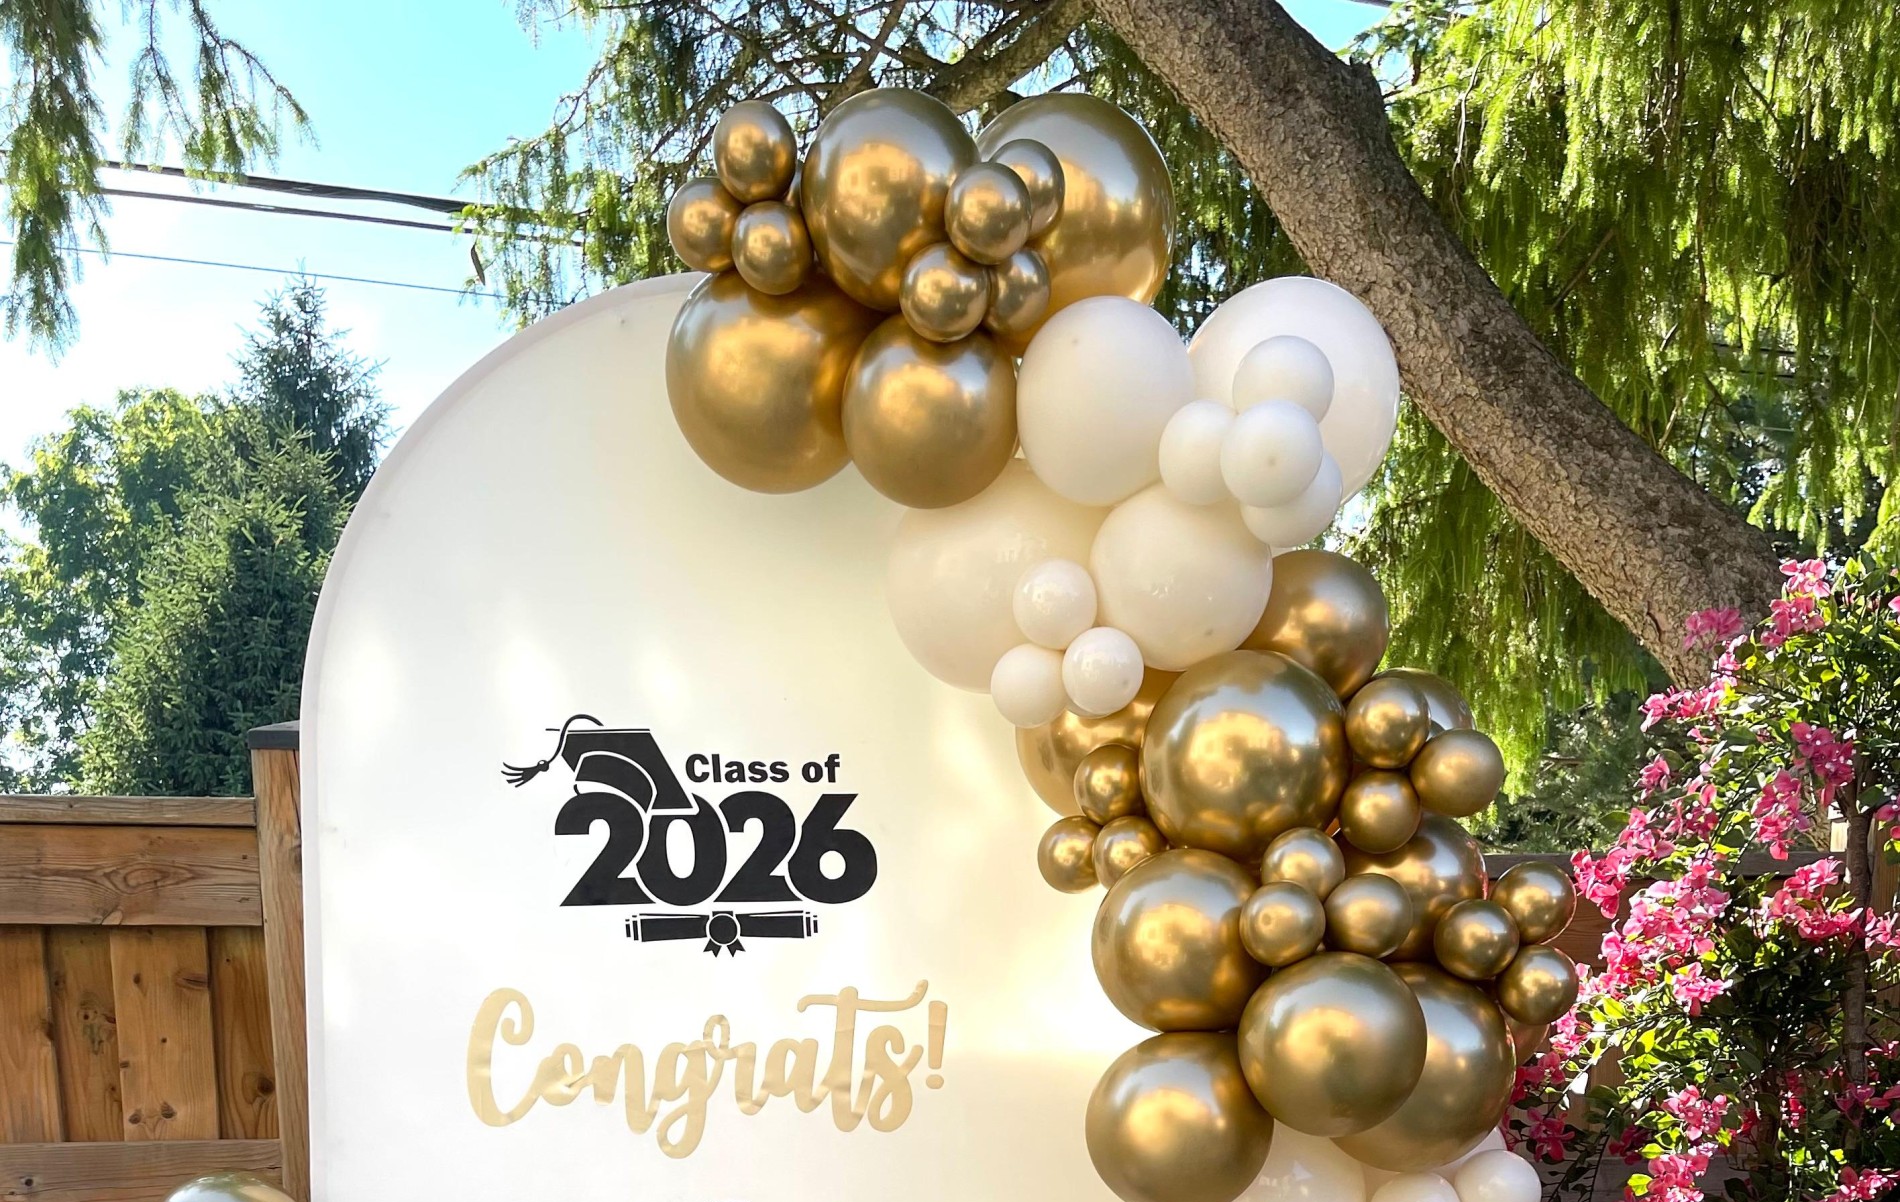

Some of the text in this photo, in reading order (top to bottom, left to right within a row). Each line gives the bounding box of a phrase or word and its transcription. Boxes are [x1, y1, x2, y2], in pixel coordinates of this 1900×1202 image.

[685, 753, 841, 784] Class of
[554, 790, 878, 907] 2026
[466, 979, 949, 1160] Congrats!
